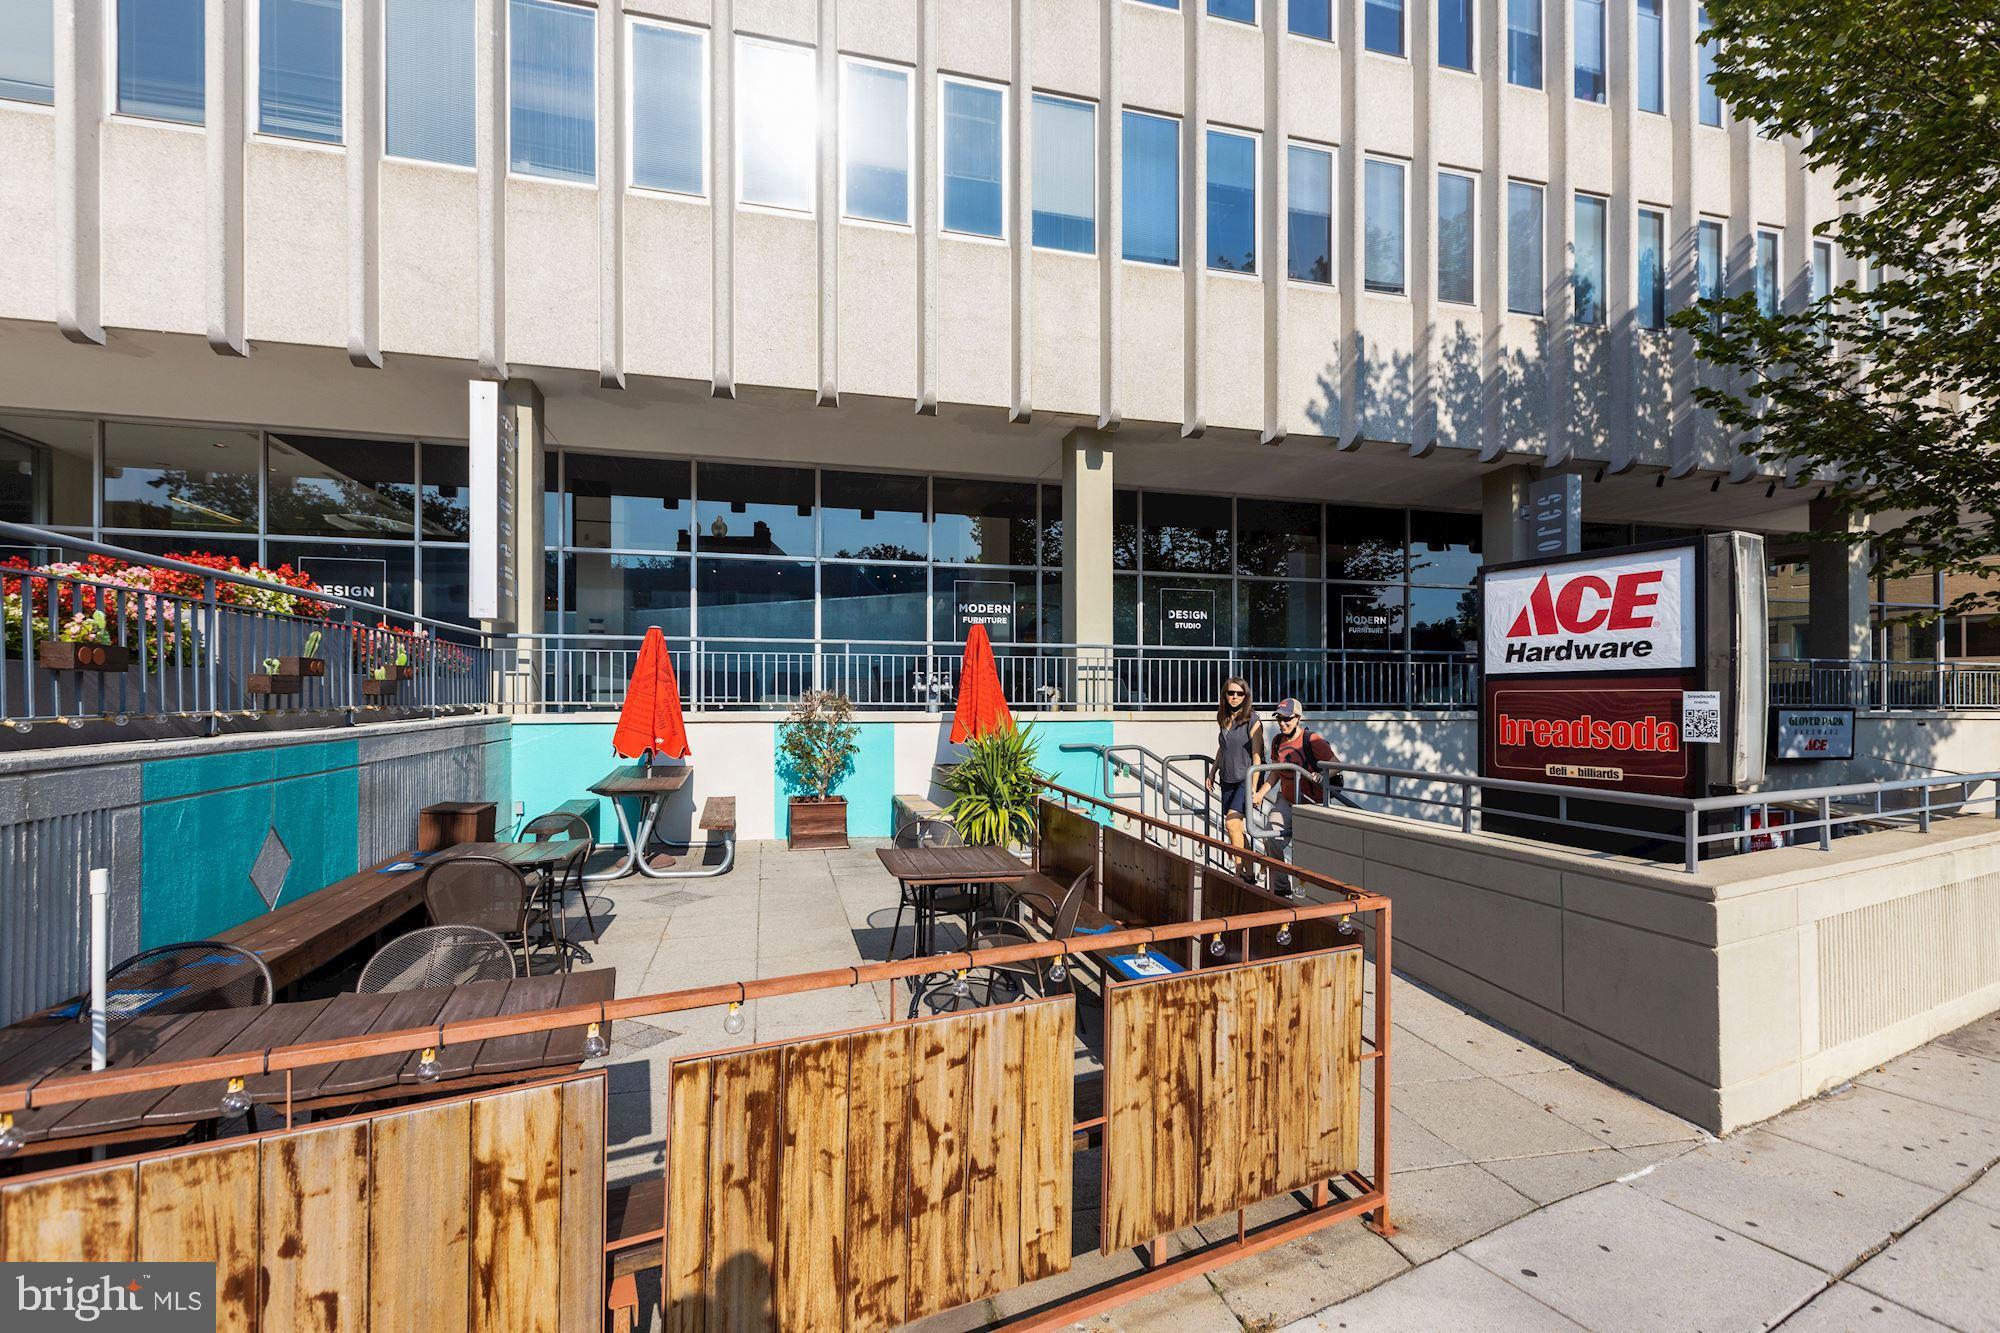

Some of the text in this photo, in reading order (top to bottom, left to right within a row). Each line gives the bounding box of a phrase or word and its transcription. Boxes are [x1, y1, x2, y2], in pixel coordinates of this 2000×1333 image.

[321, 585, 375, 597] ESIGN
[958, 603, 1011, 614] MODERN
[1506, 571, 1664, 638] ACE
[962, 616, 1008, 625] FURNITURE
[1168, 609, 1208, 620] DESIGN
[1345, 614, 1387, 625] MODERN
[1505, 639, 1653, 663] Hardware
[1788, 716, 1820, 726] GLOVER
[1499, 713, 1680, 753] breadsoda
[1804, 737, 1827, 751] ACE
[1549, 765, 1620, 780] deli billiards
